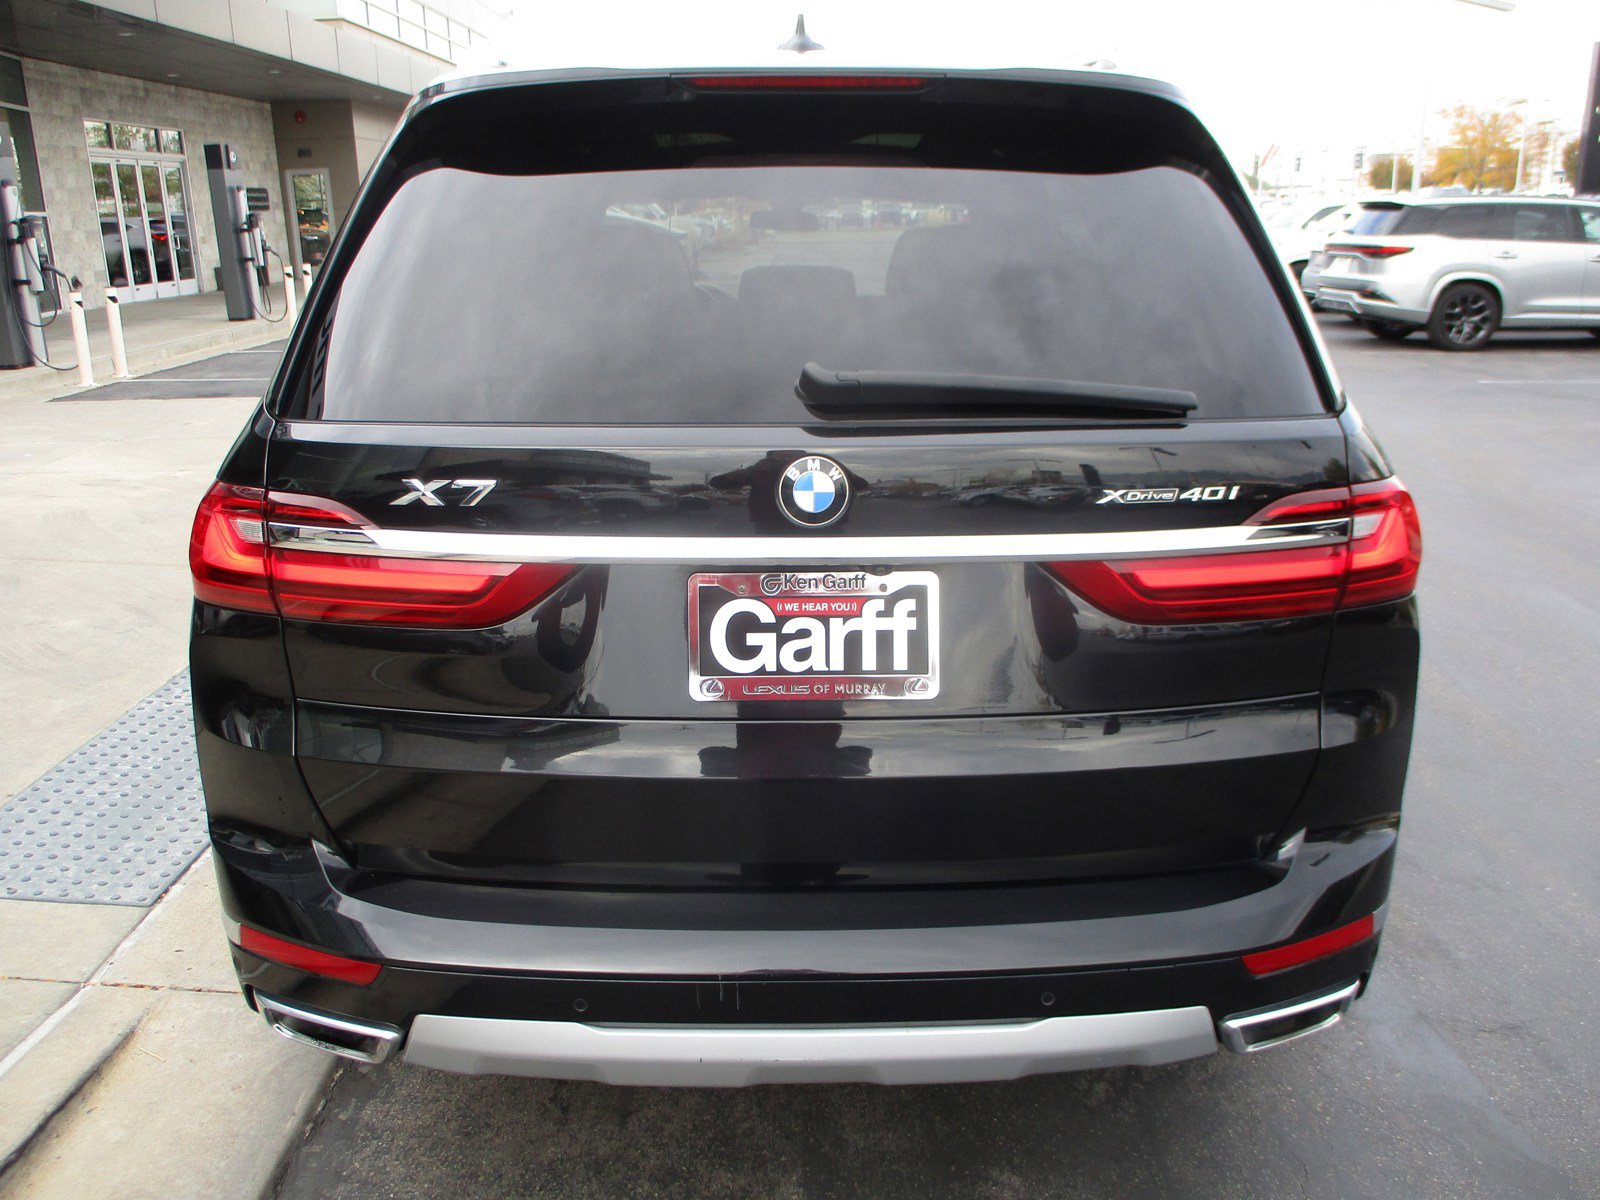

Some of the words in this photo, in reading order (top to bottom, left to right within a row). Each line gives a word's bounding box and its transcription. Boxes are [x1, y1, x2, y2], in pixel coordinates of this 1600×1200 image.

[786, 459, 843, 482] BMW
[388, 478, 498, 507] X7
[783, 573, 819, 591] Ken
[822, 573, 867, 591] Garff
[784, 603, 800, 612] WE
[801, 603, 829, 612] HEAR
[830, 602, 850, 612] YOU
[709, 598, 917, 674] Garff
[742, 685, 811, 695] LEXUS
[813, 684, 830, 694] OF
[834, 683, 886, 695] MURRAY
